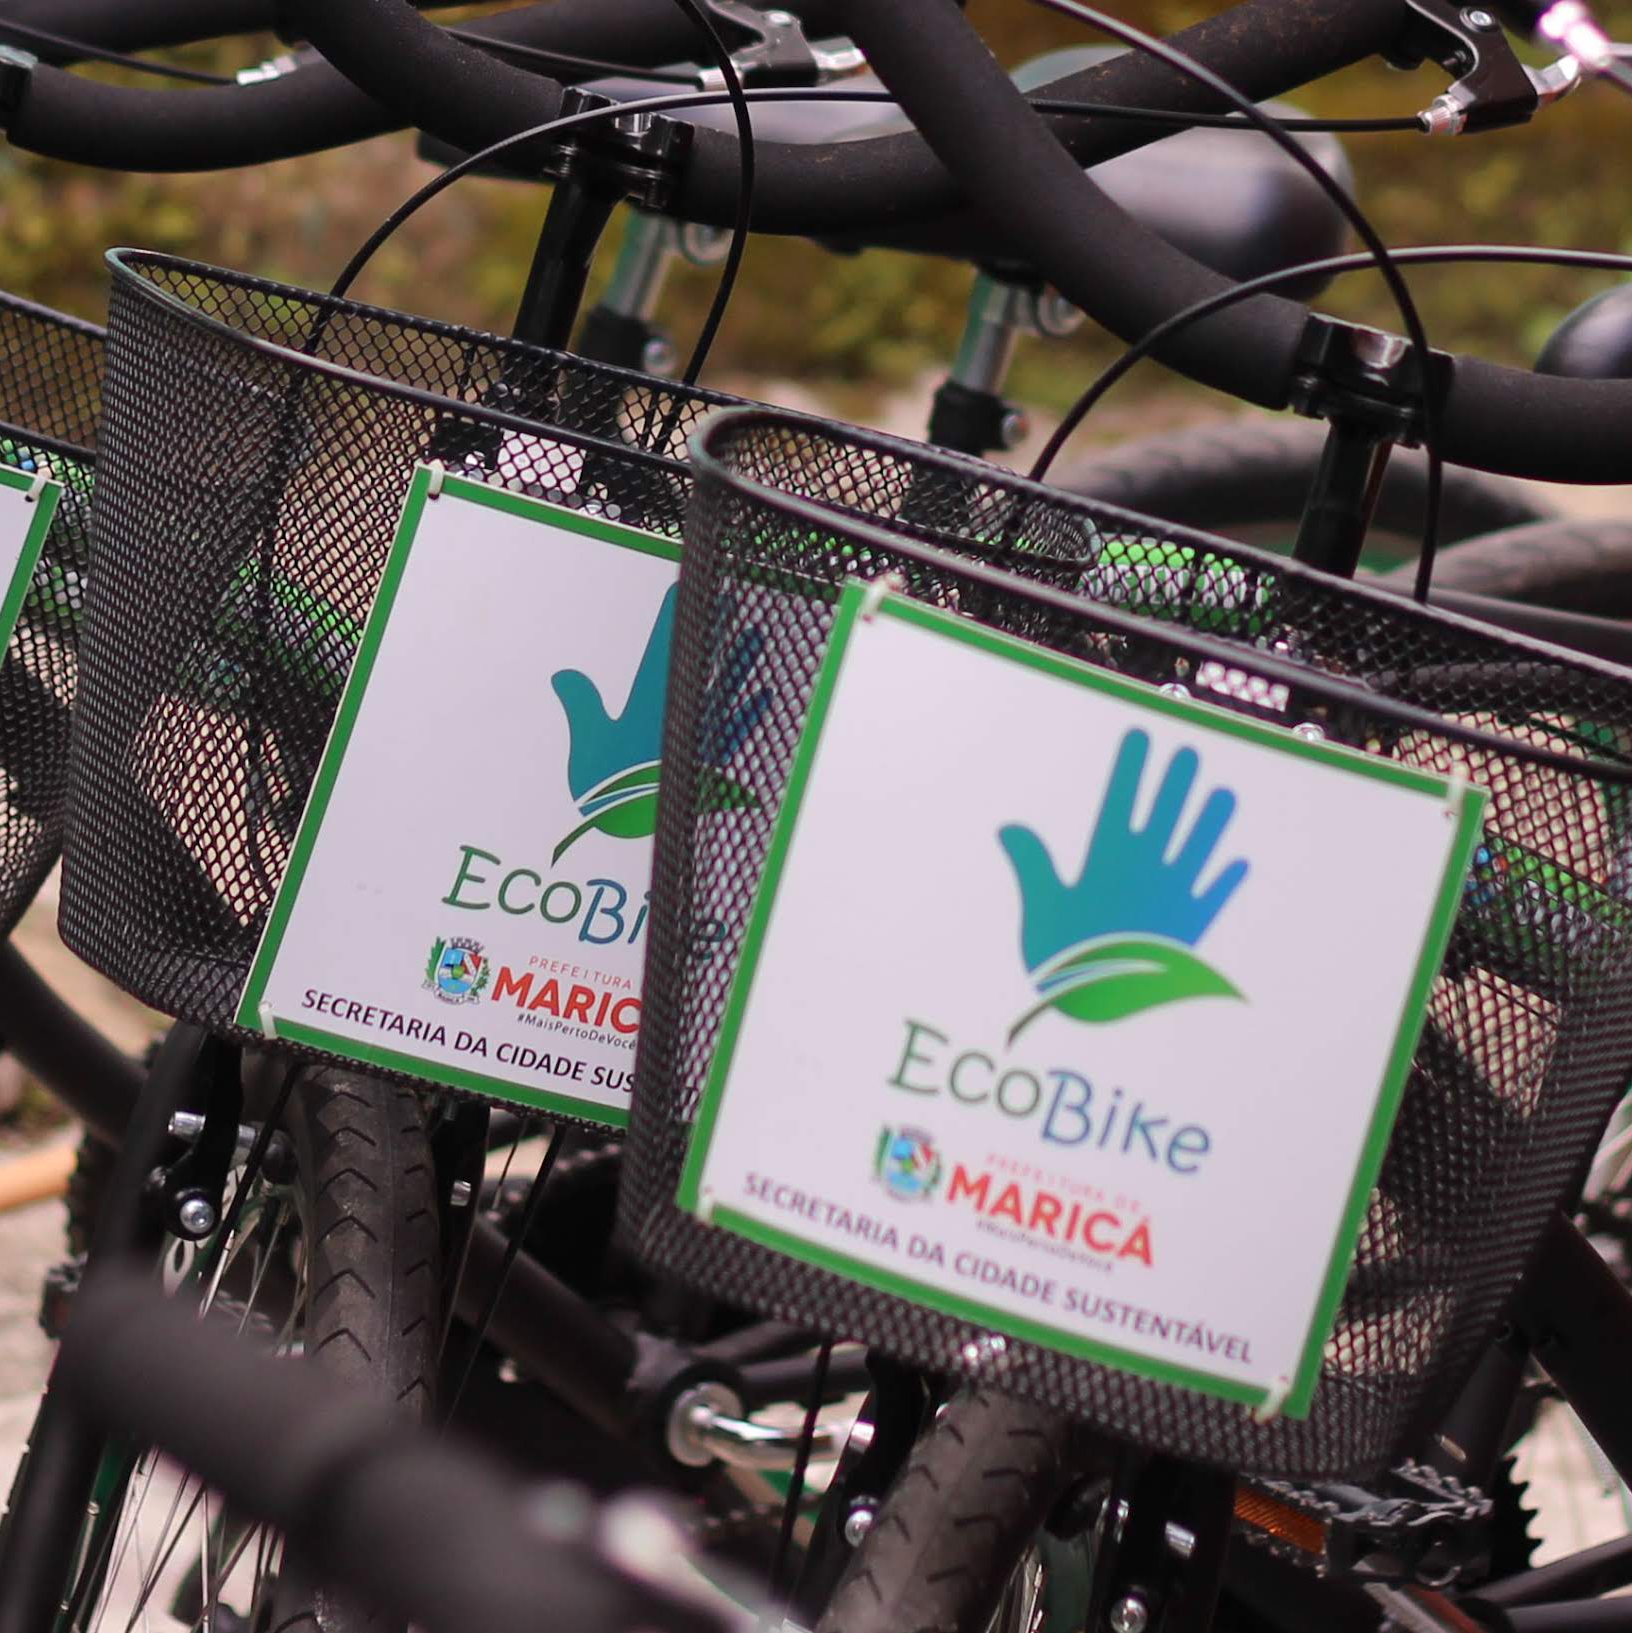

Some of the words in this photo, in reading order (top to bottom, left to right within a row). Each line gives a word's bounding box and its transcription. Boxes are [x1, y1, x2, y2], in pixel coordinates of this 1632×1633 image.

[441, 844, 651, 945] EcoBi
[491, 965, 642, 1034] MARIC
[529, 955, 632, 990] PREFEITURA
[301, 987, 447, 1048] SECRETARIA
[454, 1030, 487, 1058] DA
[496, 1042, 587, 1082] CIDADE
[886, 1018, 1212, 1176] EcoBike
[744, 1172, 899, 1249] SECRETARIA
[907, 1234, 945, 1266] DA
[954, 1251, 1058, 1304] CIDADE
[1063, 1287, 1253, 1364] SUSTENTÁVEL
